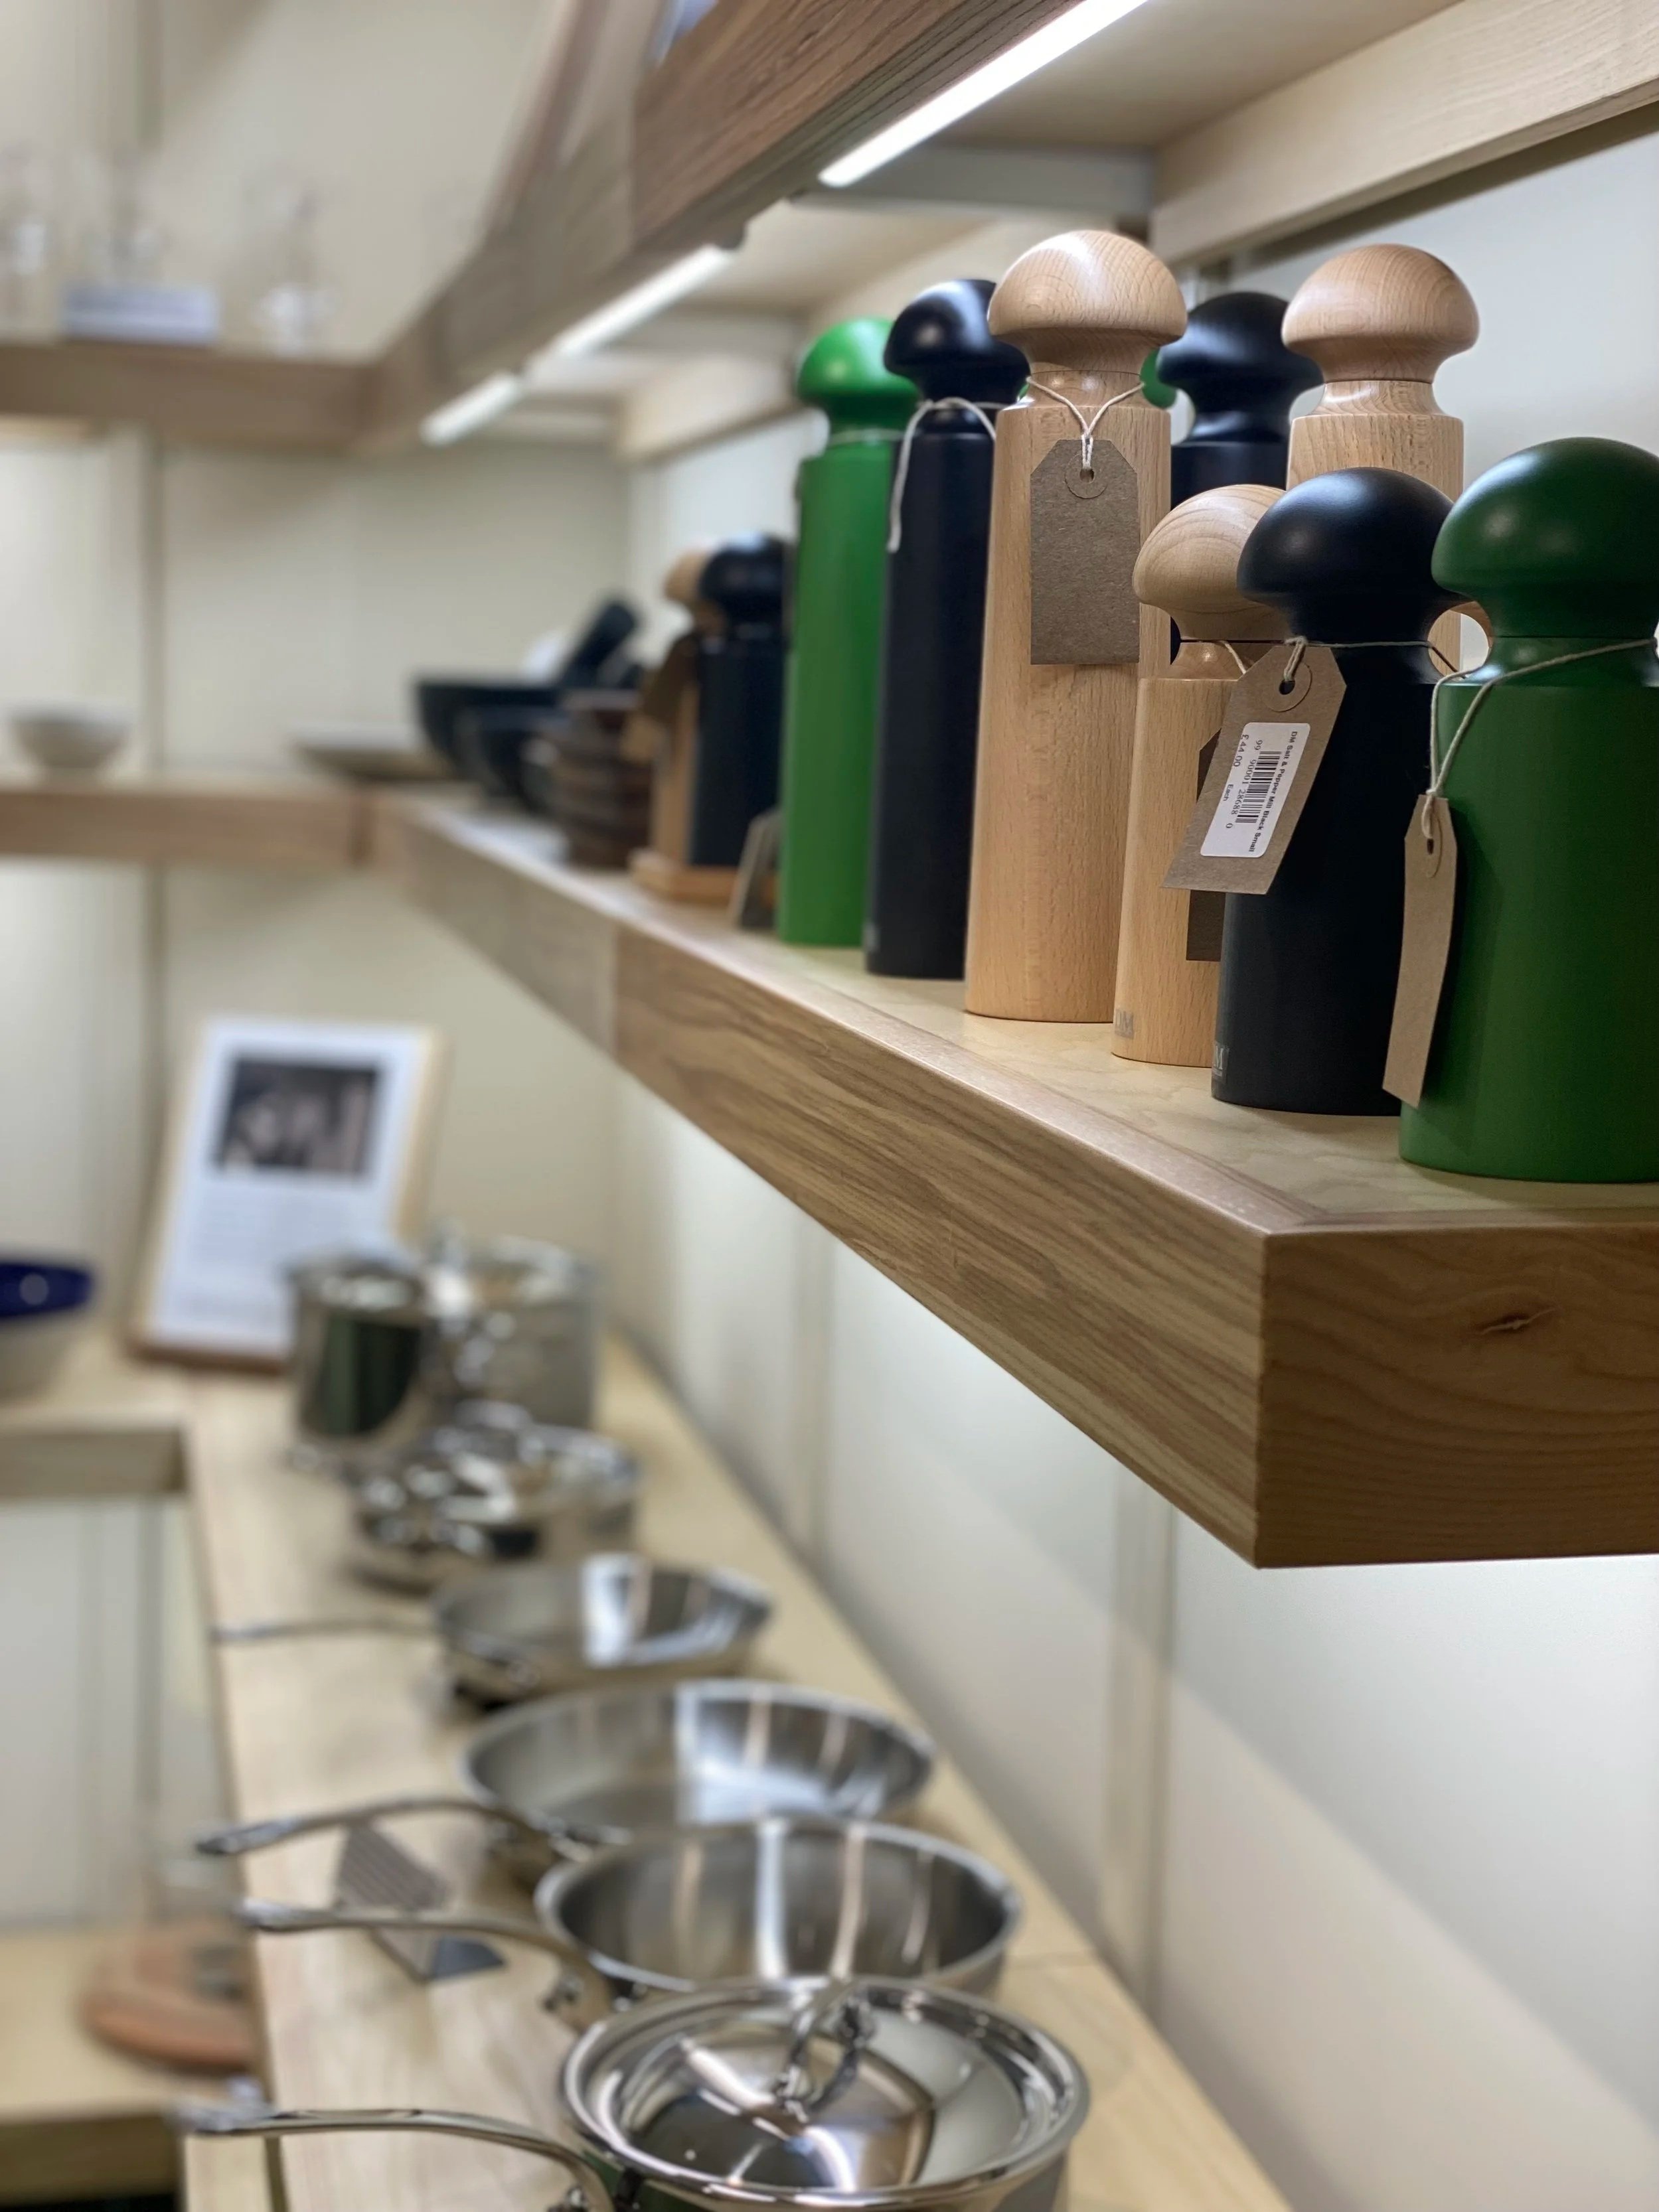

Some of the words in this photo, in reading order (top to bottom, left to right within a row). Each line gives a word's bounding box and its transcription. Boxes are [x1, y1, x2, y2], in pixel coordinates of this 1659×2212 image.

[1254, 739, 1263, 751] 99
[1289, 731, 1298, 743] DM
[1284, 745, 1293, 759] Salt
[1242, 759, 1257, 784] 90001
[1271, 769, 1285, 794] Pepper
[1223, 784, 1233, 801] Each
[1231, 789, 1246, 815] 28688
[1265, 796, 1275, 808] Mill
[1257, 810, 1269, 830] Black
[1249, 832, 1261, 852] Small
